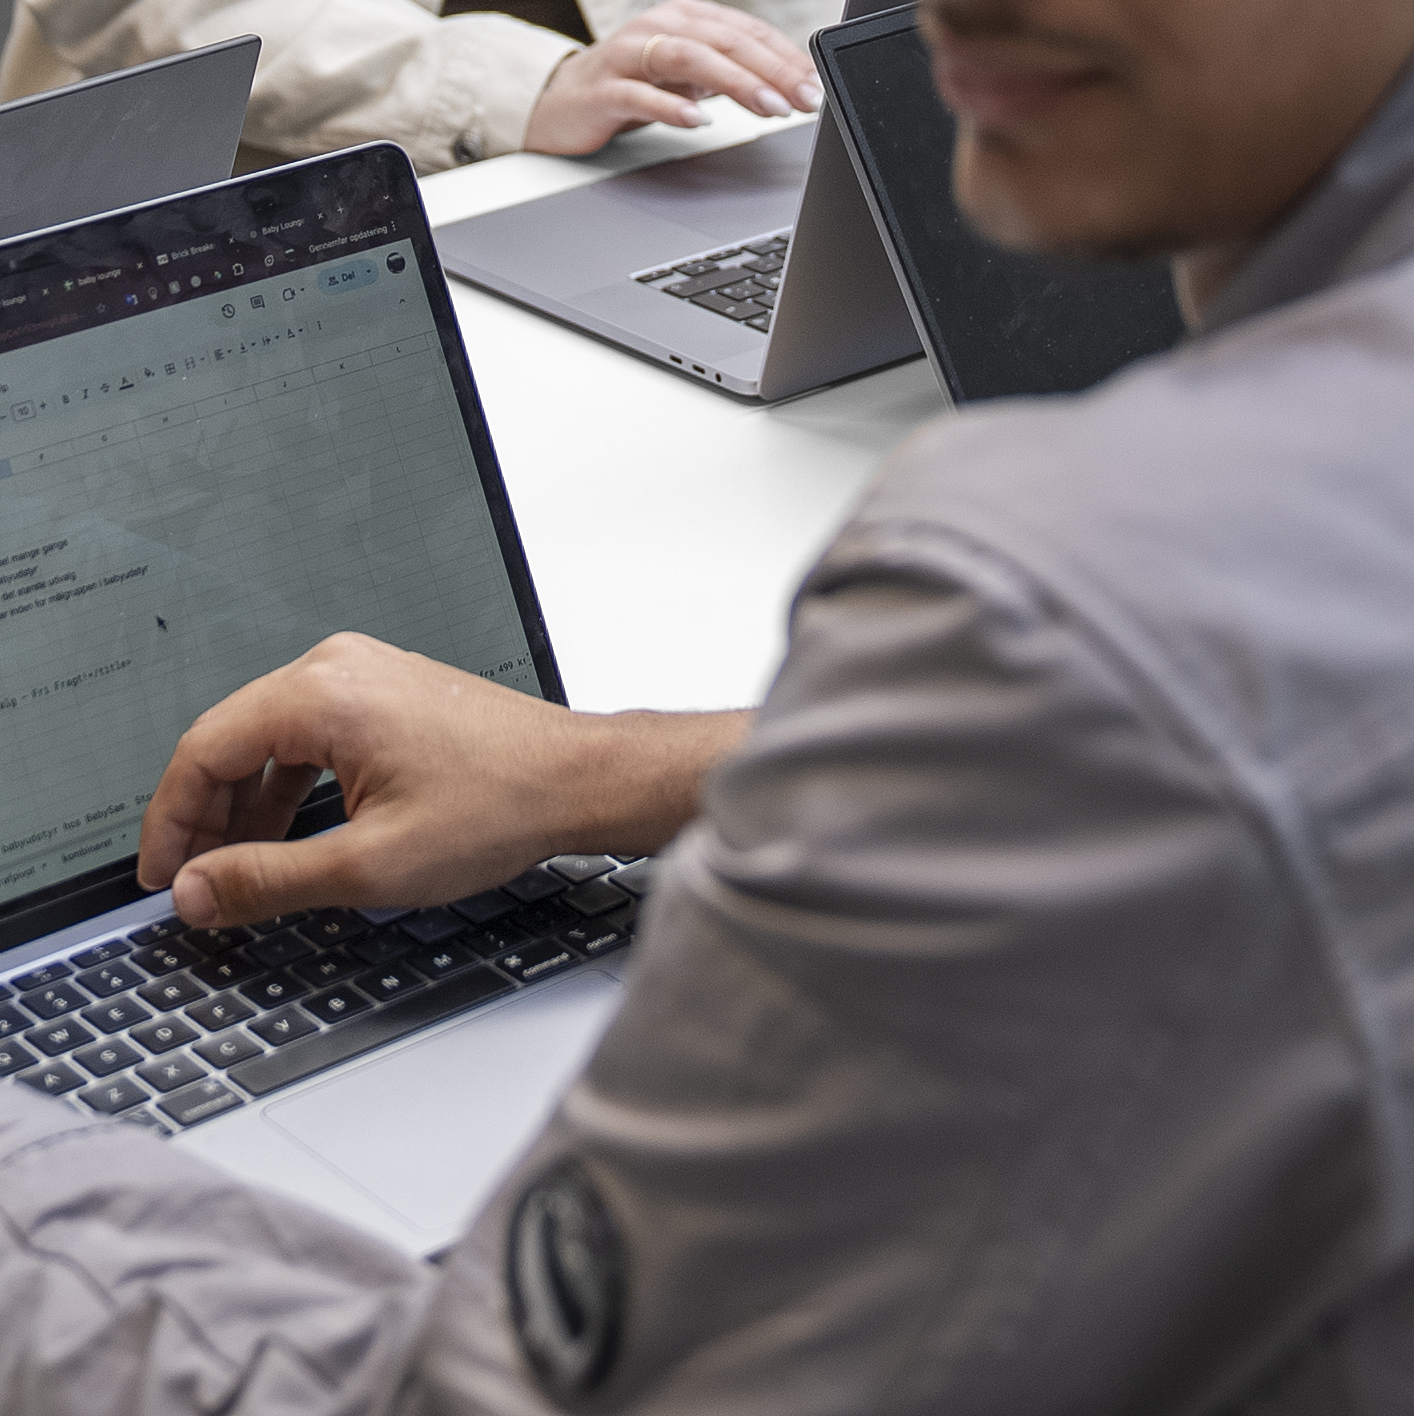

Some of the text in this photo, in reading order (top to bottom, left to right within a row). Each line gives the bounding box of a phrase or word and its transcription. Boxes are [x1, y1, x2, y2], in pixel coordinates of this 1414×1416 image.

[260, 223, 280, 236] Baby
[308, 222, 388, 253] Gennemfør opdatering
[170, 248, 189, 260] Brick
[76, 266, 122, 287] baby lounge
[339, 266, 355, 279] Del
[479, 669, 495, 679] fra
[499, 661, 514, 673] 499
[586, 933, 617, 951] option
[522, 952, 570, 978] command
